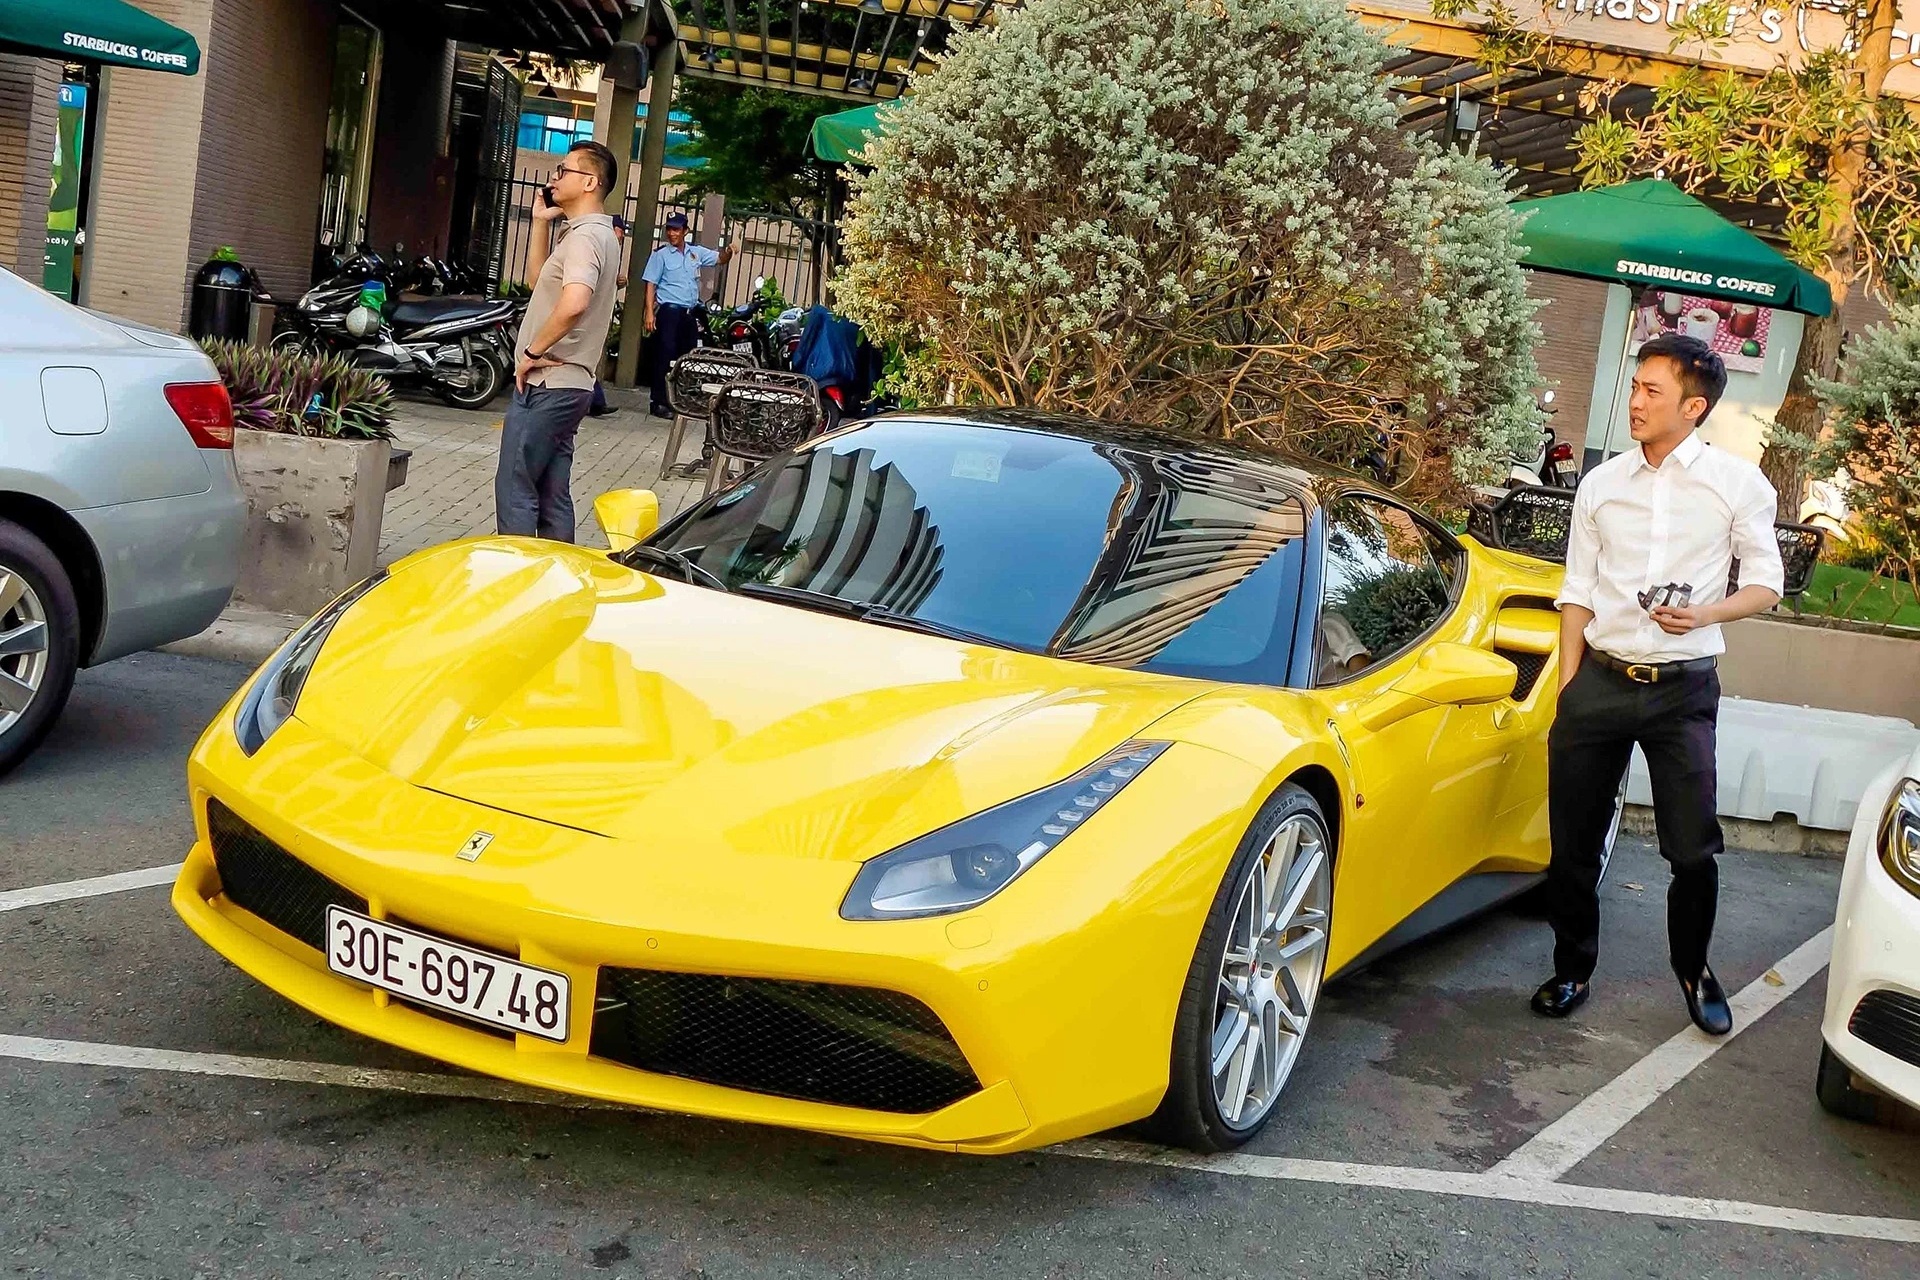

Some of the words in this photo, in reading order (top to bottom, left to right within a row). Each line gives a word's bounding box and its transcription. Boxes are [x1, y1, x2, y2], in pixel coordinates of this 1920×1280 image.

[63, 32, 138, 59] STARBUCKS
[141, 48, 188, 68] COFFEE
[1616, 260, 1713, 286] STARBUCKS
[1716, 276, 1776, 297] COFFEE
[336, 919, 559, 1030] 30E-697.48
